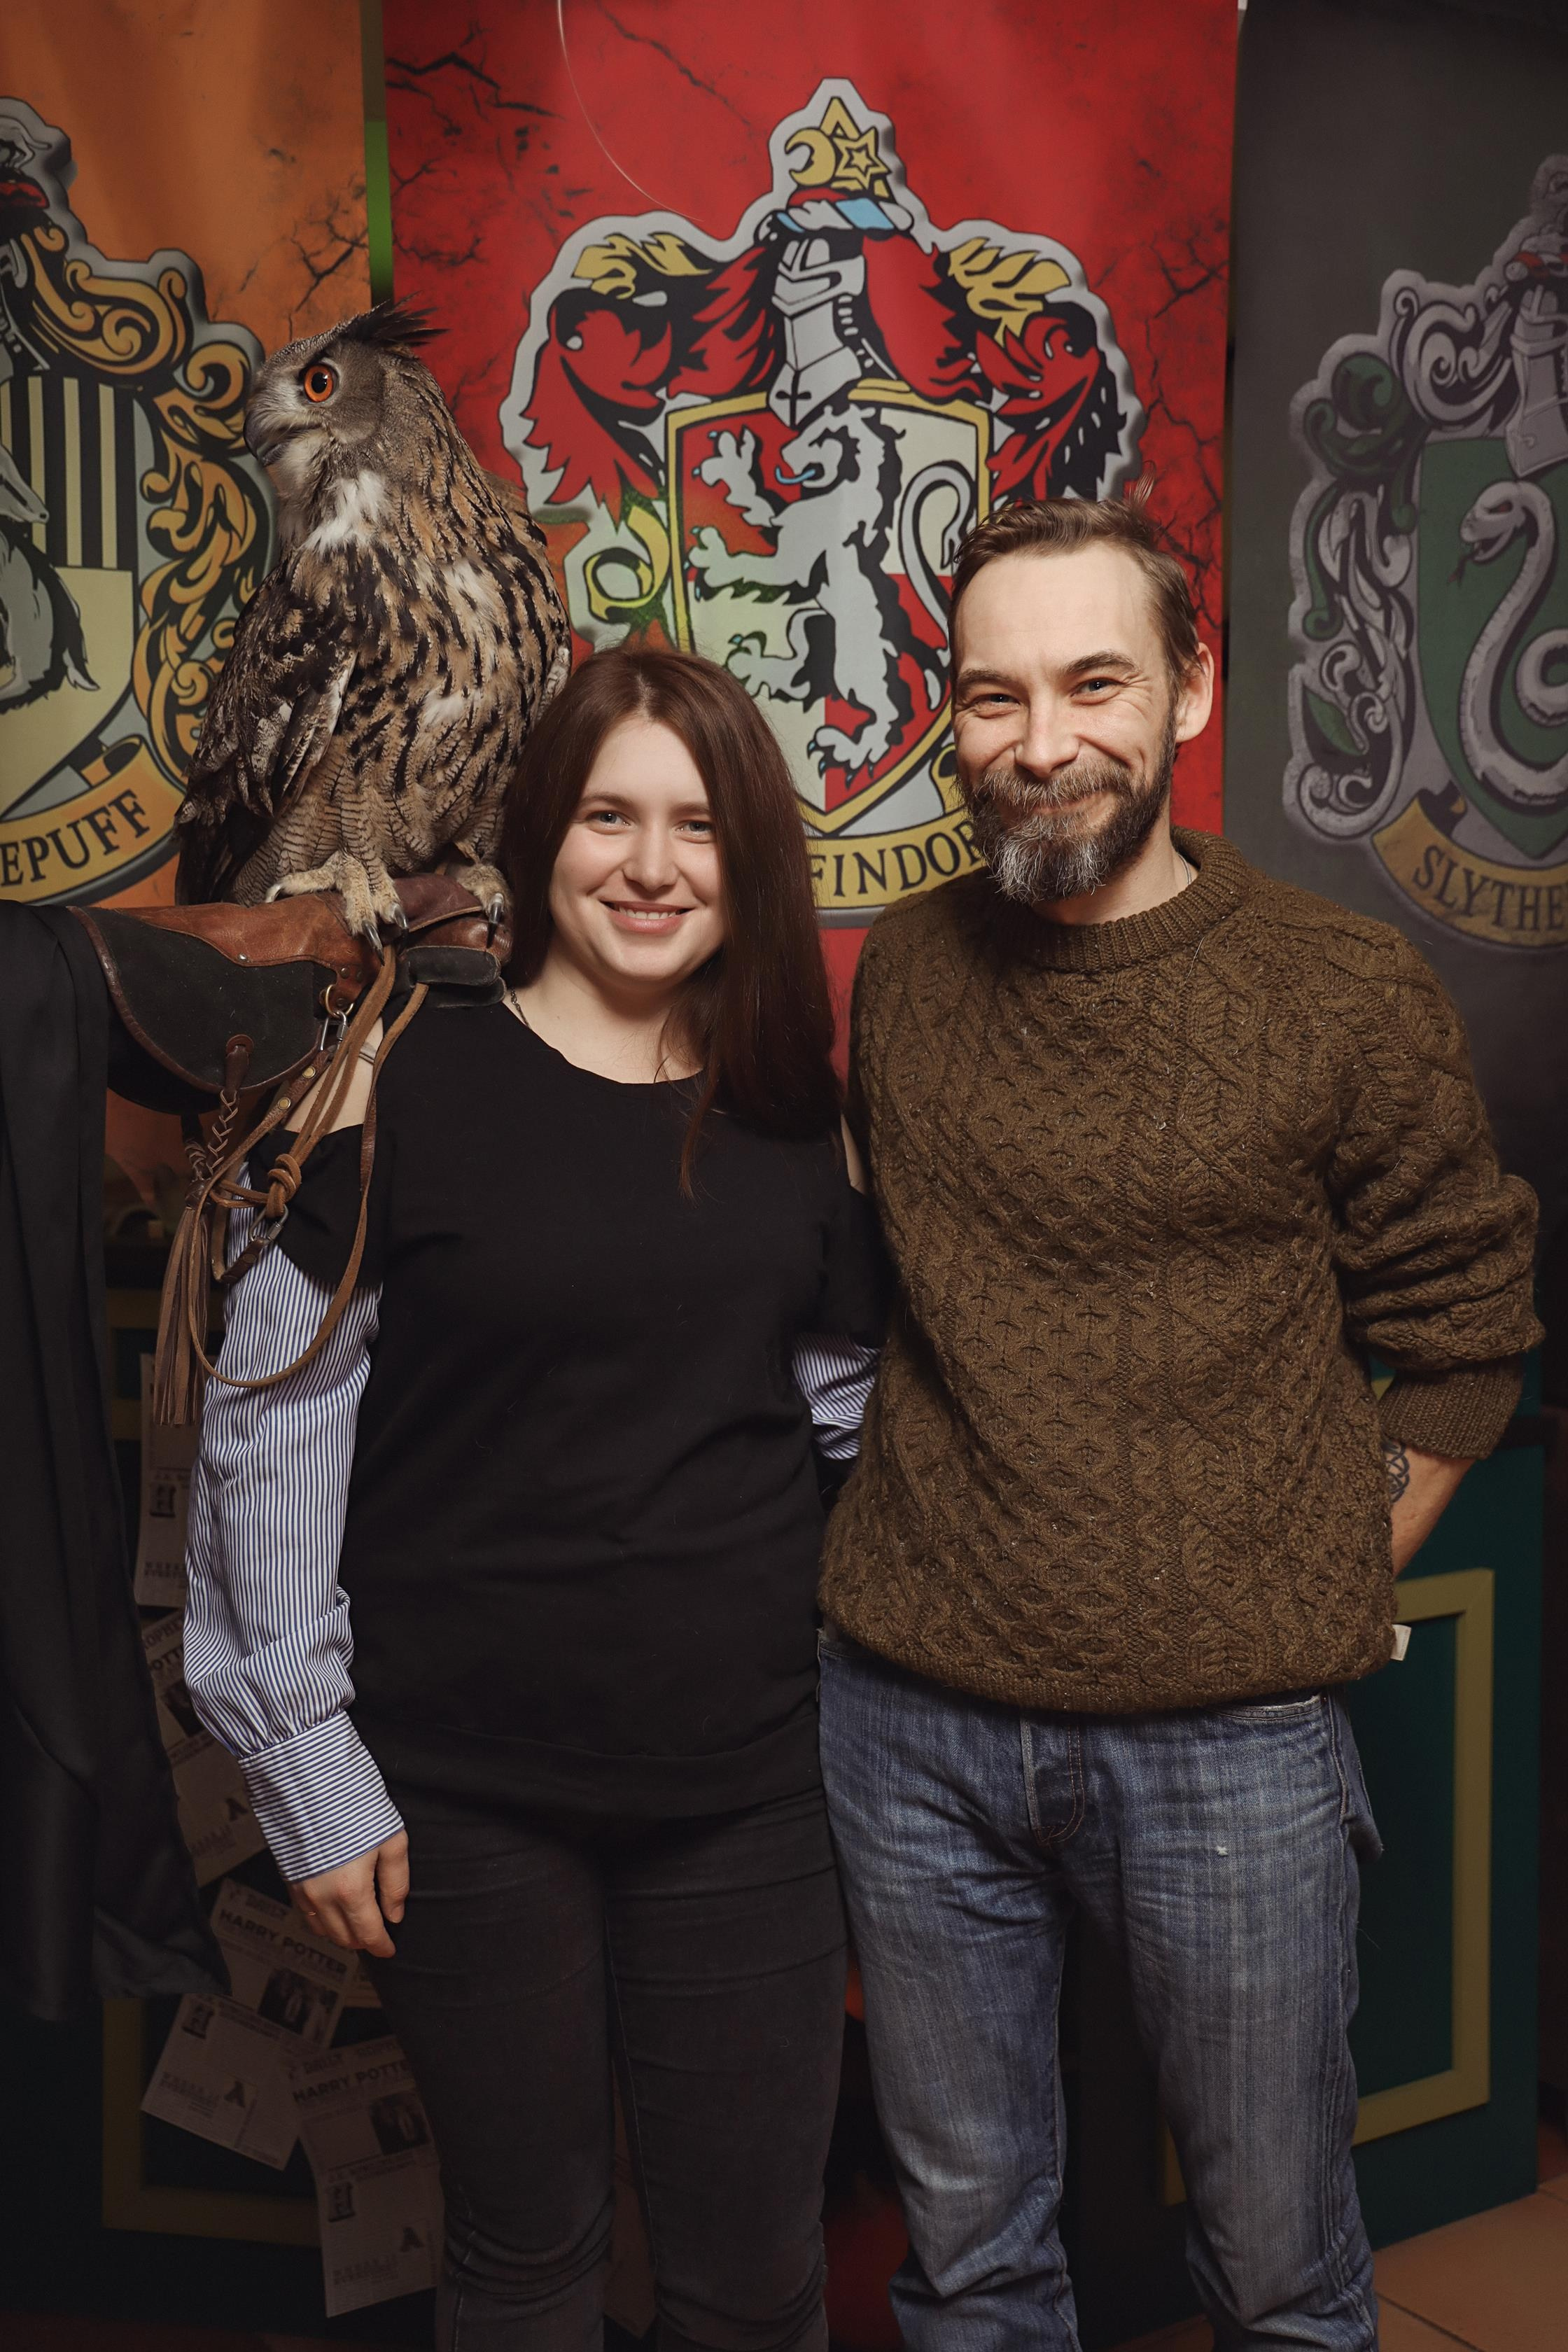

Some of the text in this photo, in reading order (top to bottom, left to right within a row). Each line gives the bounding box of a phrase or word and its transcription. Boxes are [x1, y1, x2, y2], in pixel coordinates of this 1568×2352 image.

[0, 788, 150, 887] EPUFF
[1412, 845, 1564, 931] SLYTHE
[150, 1645, 183, 1670] OTT
[220, 1909, 279, 1942] HARRY
[283, 1936, 346, 1975] POTTER
[293, 2076, 349, 2102] HARRY
